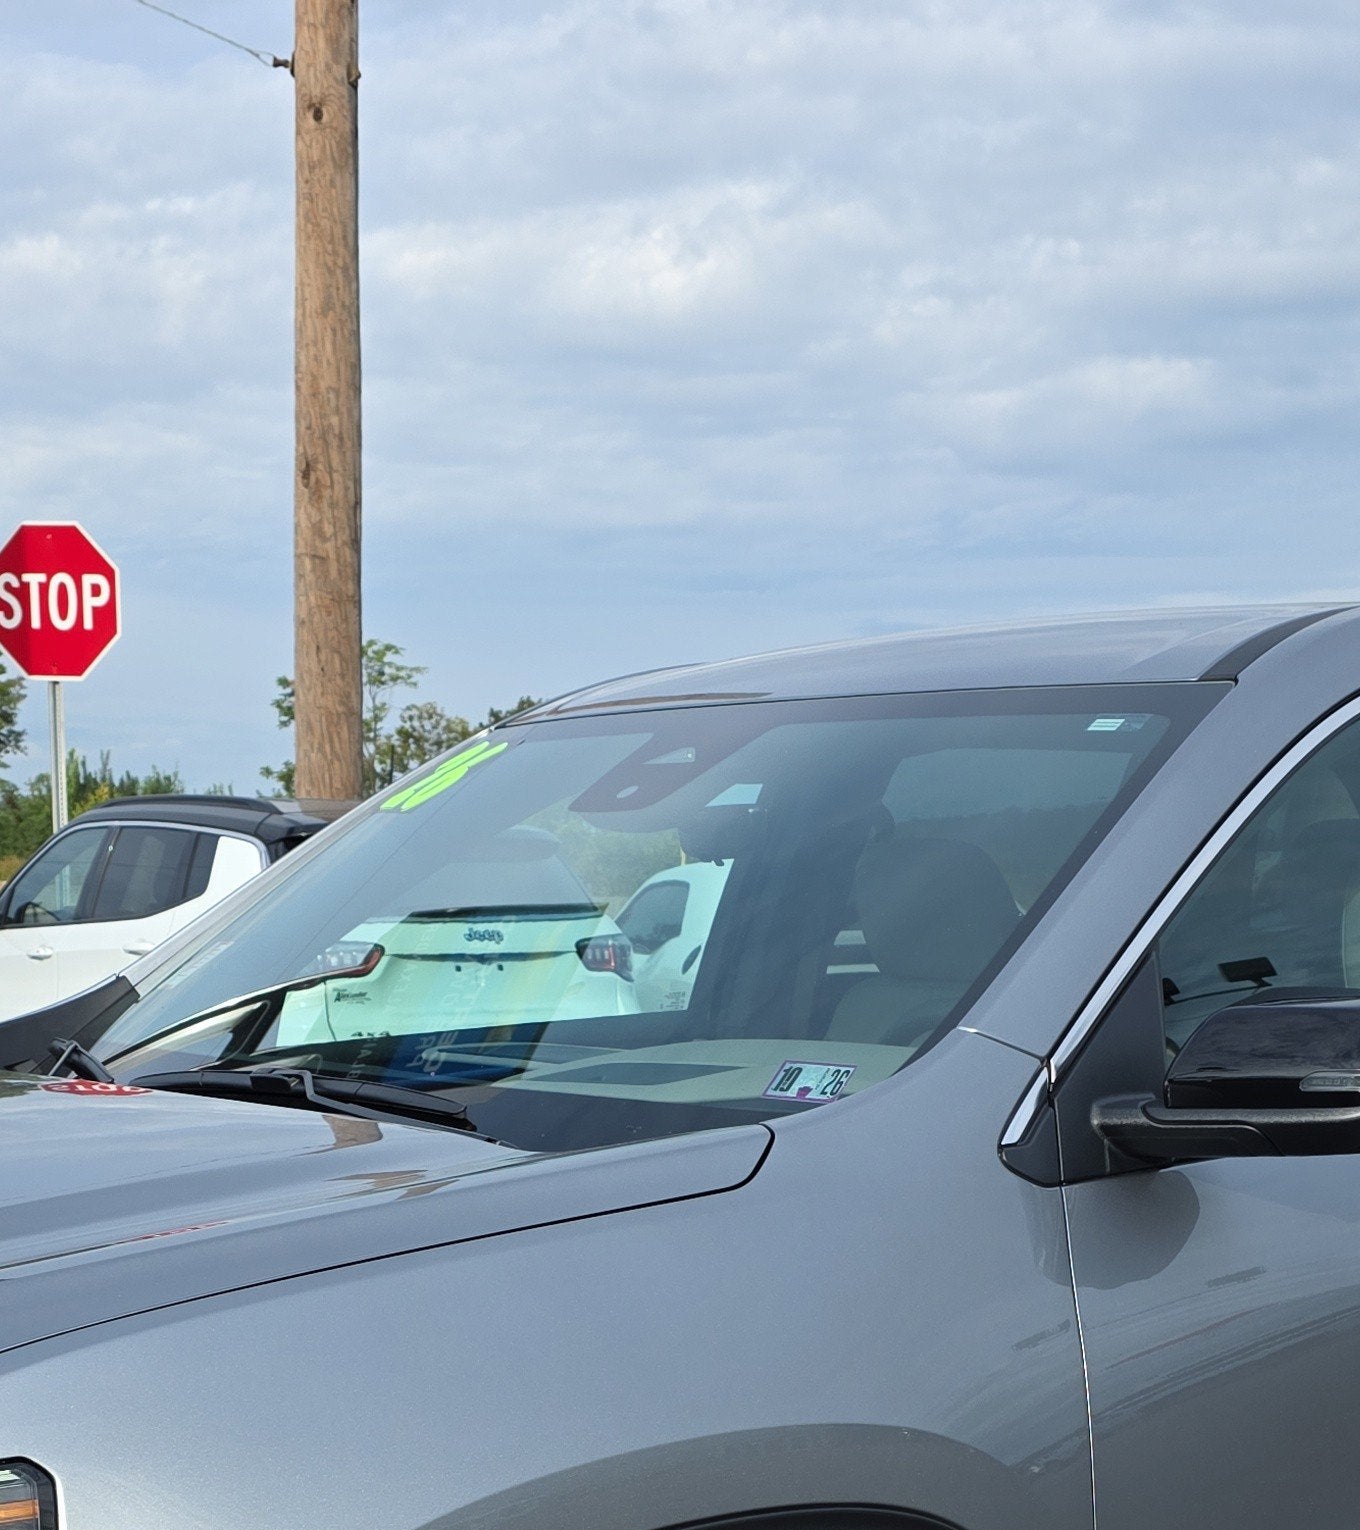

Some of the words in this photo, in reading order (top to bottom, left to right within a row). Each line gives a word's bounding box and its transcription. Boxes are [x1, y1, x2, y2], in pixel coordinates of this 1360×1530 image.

[463, 927, 504, 945] Jeep
[771, 1066, 804, 1092] 10
[820, 1068, 851, 1096] 26
